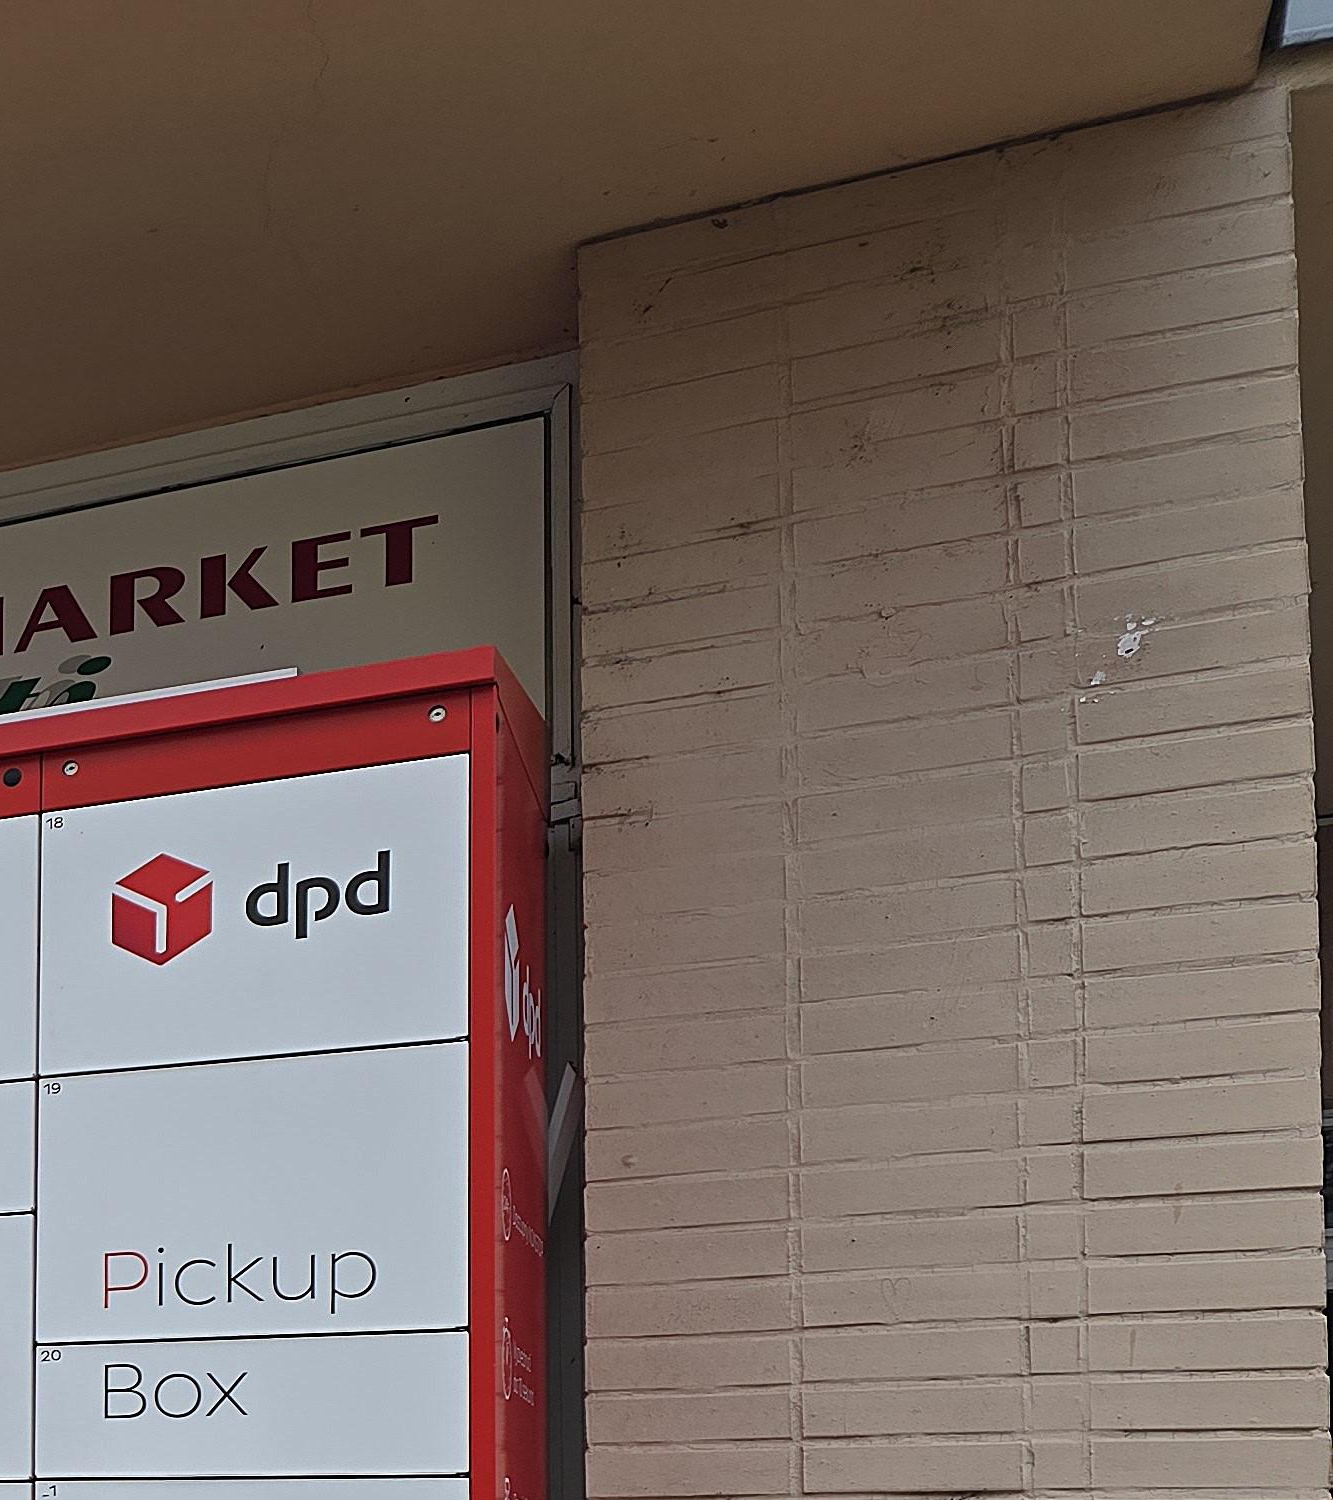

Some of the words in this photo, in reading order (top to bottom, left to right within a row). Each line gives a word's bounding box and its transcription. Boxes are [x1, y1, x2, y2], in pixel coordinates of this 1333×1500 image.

[45, 816, 64, 830] 18
[245, 850, 391, 939] dpd
[43, 1082, 61, 1096] 19
[103, 1243, 377, 1314] Pickup
[40, 1350, 62, 1362] 20
[104, 1363, 248, 1420] Box
